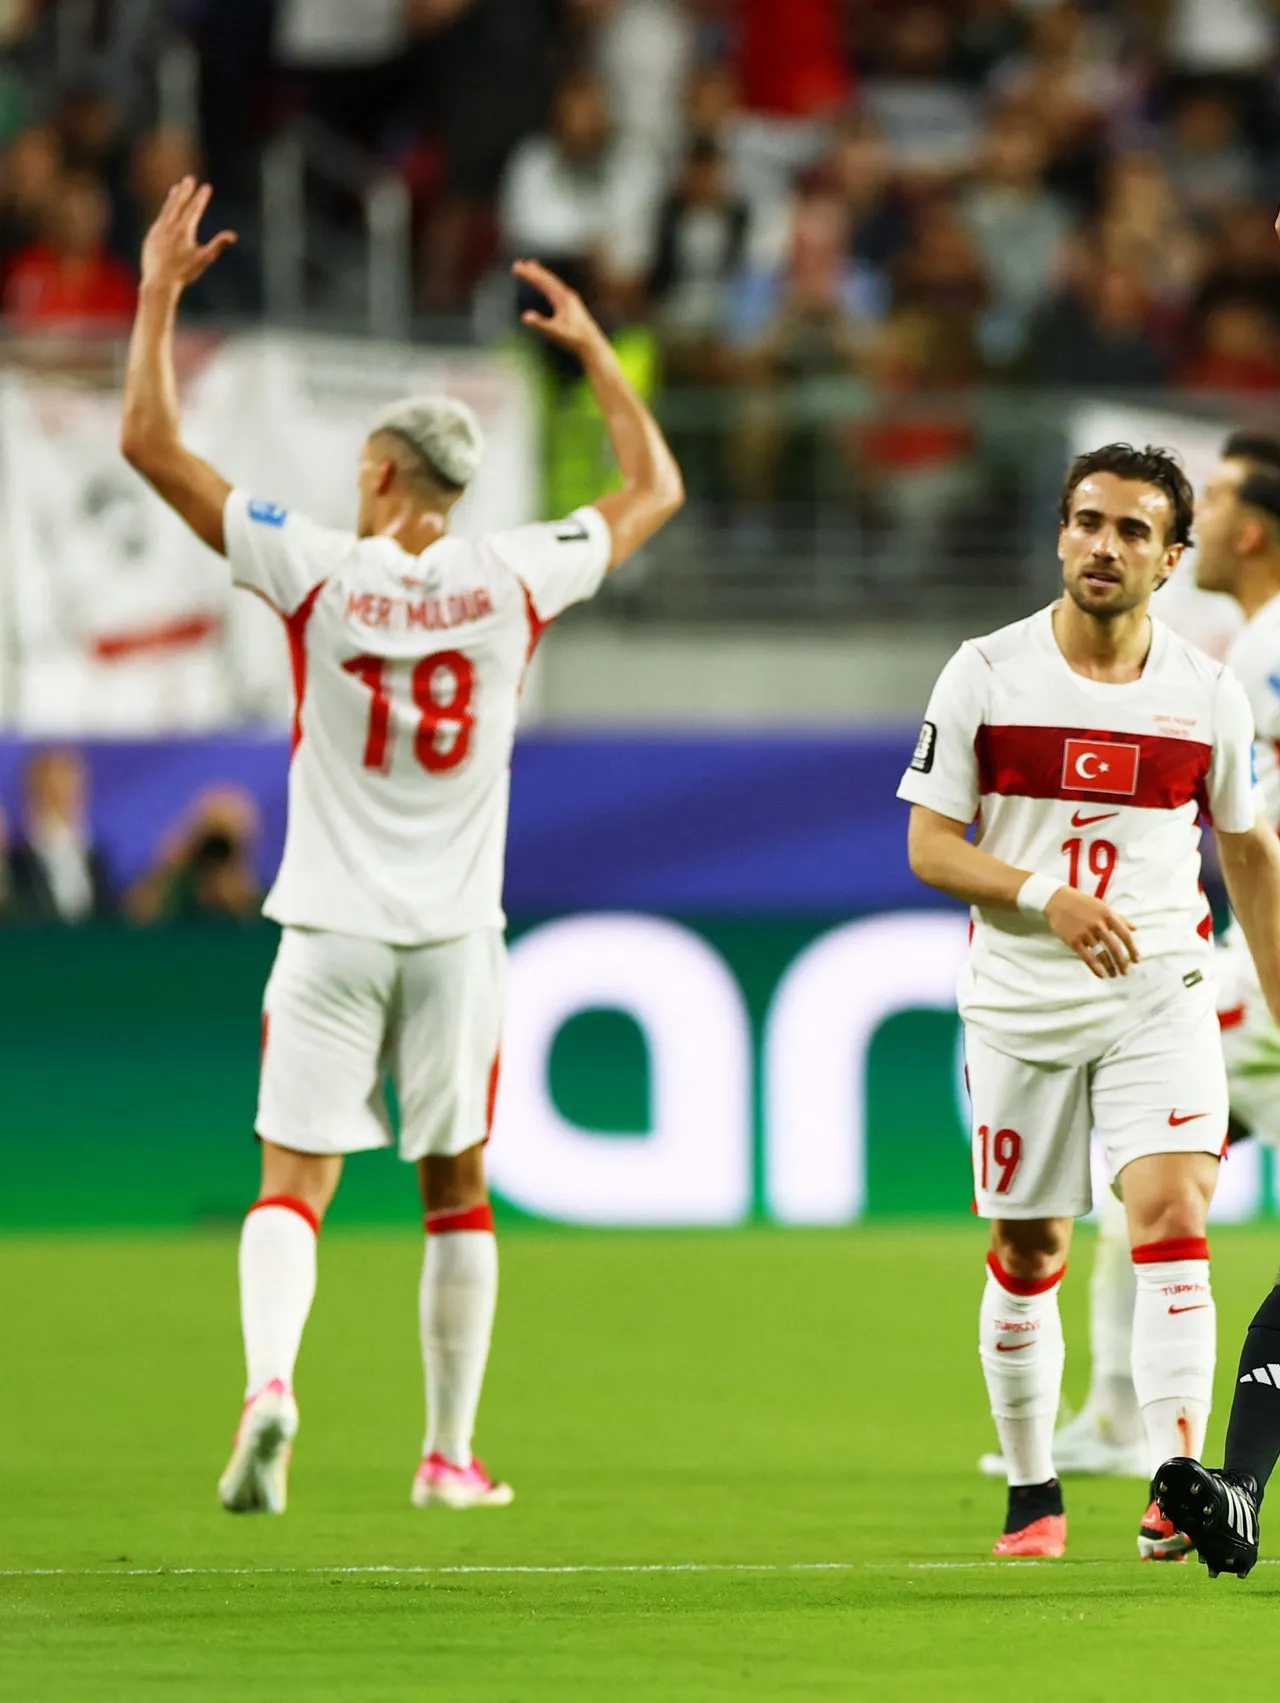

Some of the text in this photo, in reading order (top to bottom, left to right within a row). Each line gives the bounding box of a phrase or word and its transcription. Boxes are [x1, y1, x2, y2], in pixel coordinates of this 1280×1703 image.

[340, 649, 478, 776] 18
[1061, 837, 1118, 900] 19
[978, 1125, 1022, 1194] 19
